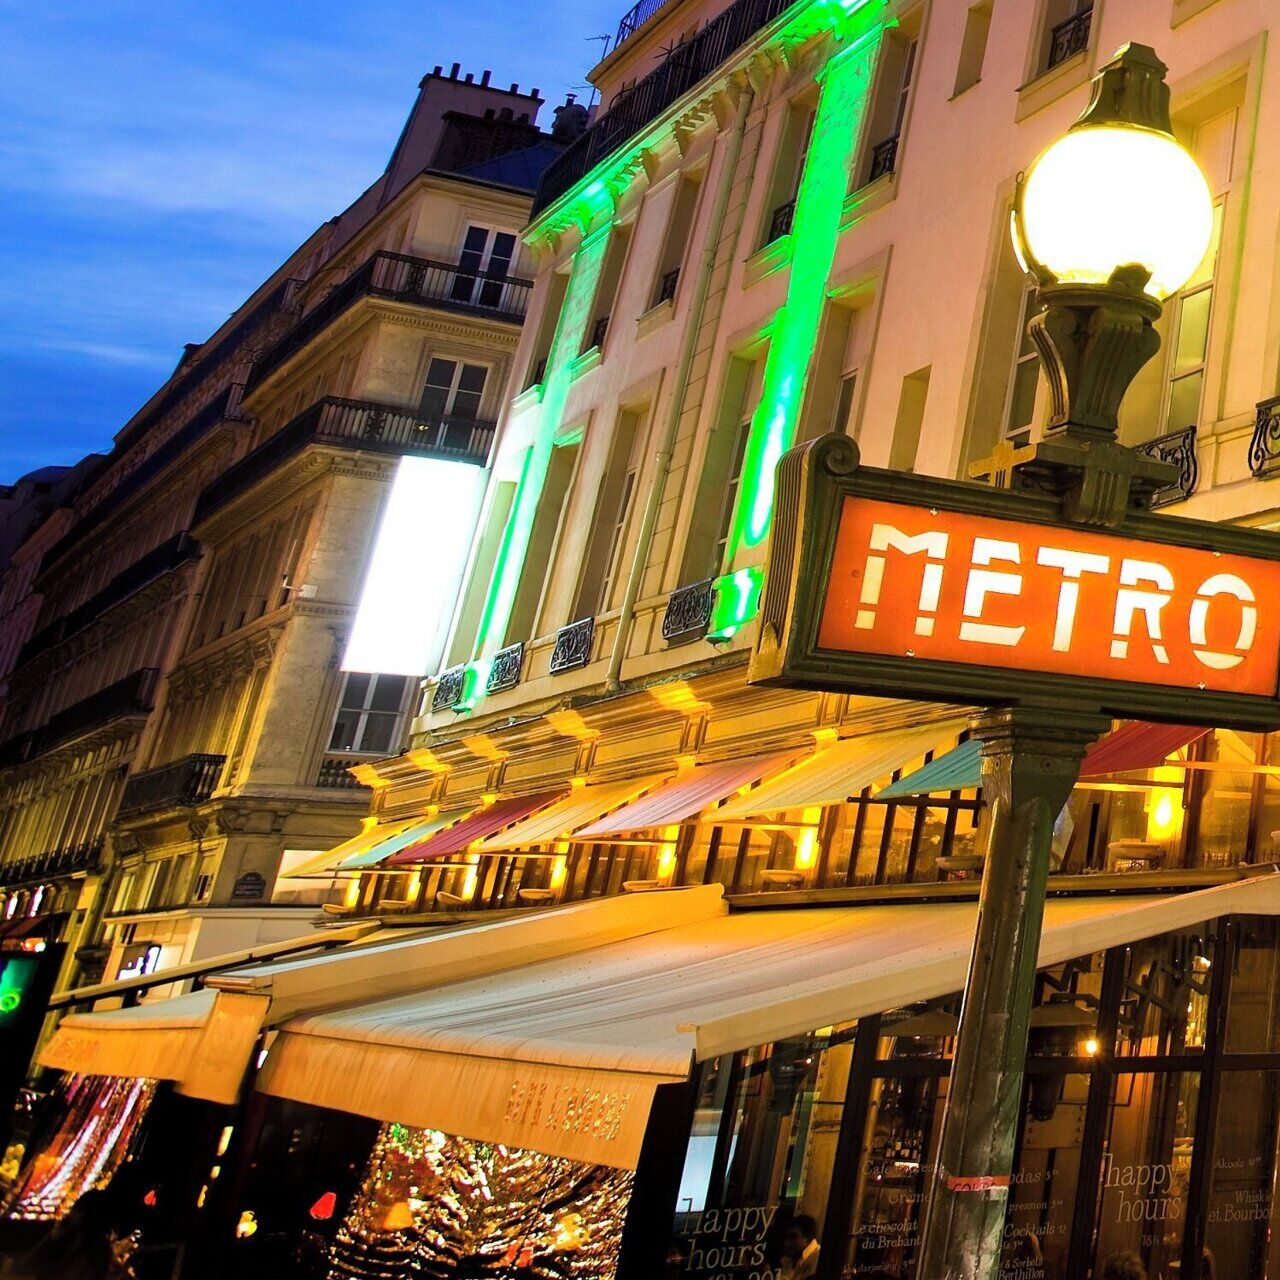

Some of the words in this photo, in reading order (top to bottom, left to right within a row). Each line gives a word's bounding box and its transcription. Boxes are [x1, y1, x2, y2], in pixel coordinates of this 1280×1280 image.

[853, 522, 1259, 670] METRO
[1010, 1167, 1042, 1185] odas
[1102, 1152, 1178, 1195] happy
[1116, 1190, 1182, 1223] hours
[1208, 1207, 1222, 1223] et
[680, 1197, 780, 1243] happy
[868, 1218, 919, 1234] chocolat
[1004, 1221, 1055, 1239] Cocktails
[684, 1238, 768, 1272] hours
[862, 1237, 875, 1250] du
